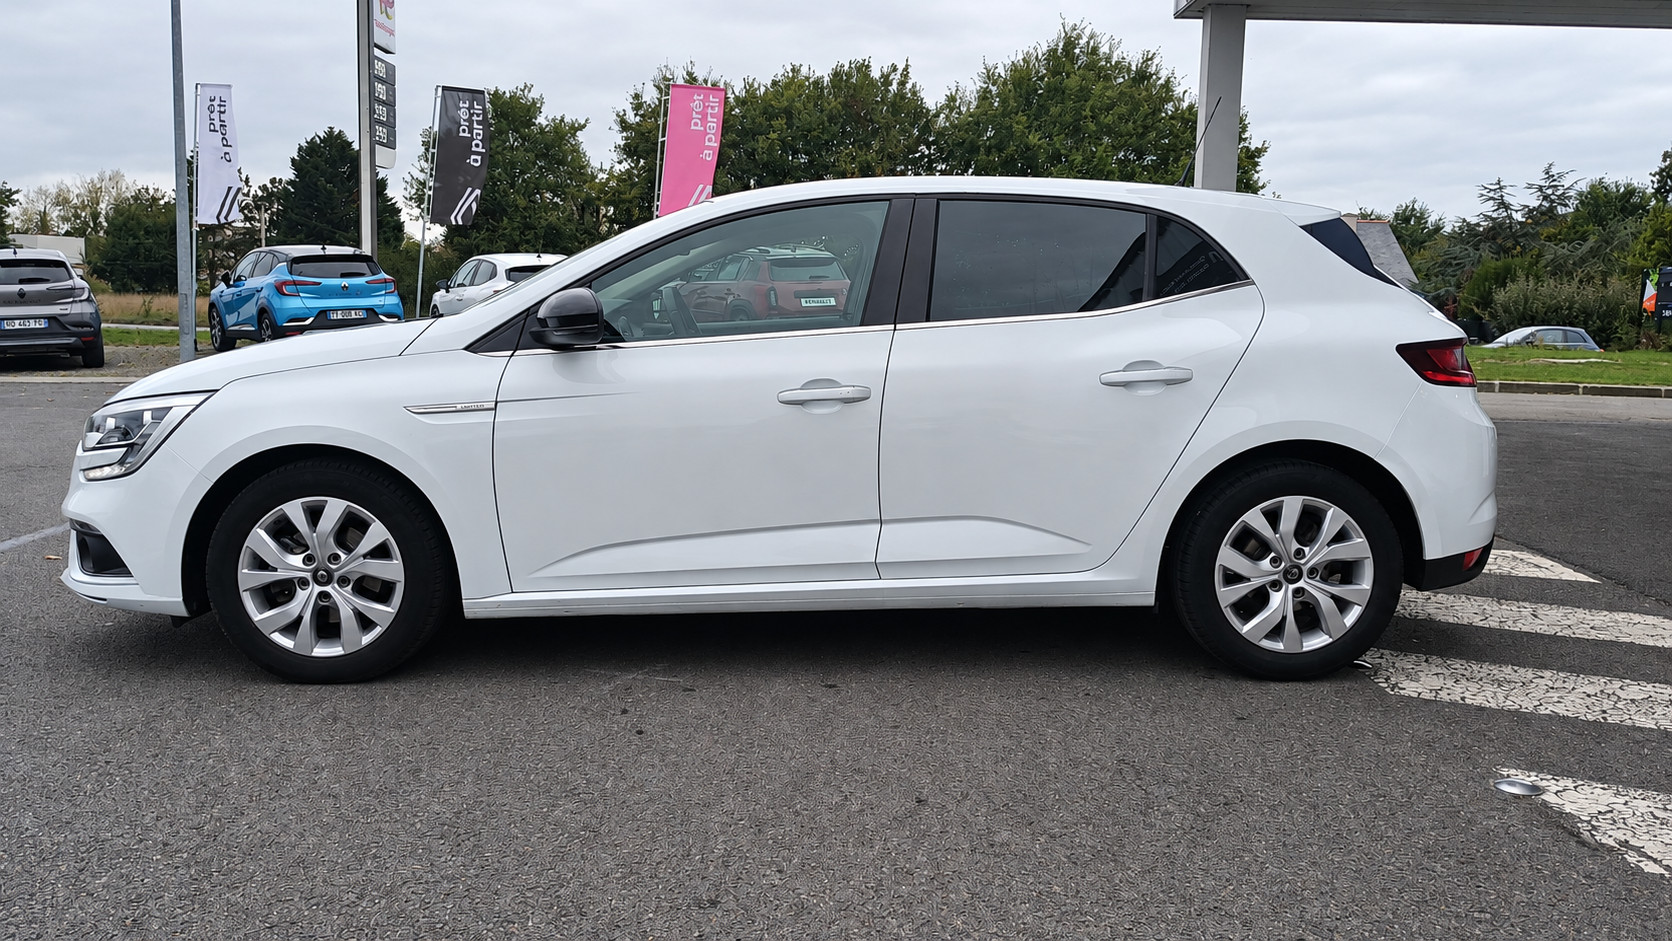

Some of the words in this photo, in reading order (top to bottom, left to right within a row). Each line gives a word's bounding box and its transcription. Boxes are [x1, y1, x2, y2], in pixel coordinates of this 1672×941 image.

[217, 96, 232, 148] partir
[457, 100, 471, 137] prêt
[470, 101, 486, 152] partir
[690, 93, 704, 131] prêt
[705, 94, 719, 147] partir
[700, 150, 713, 161] à
